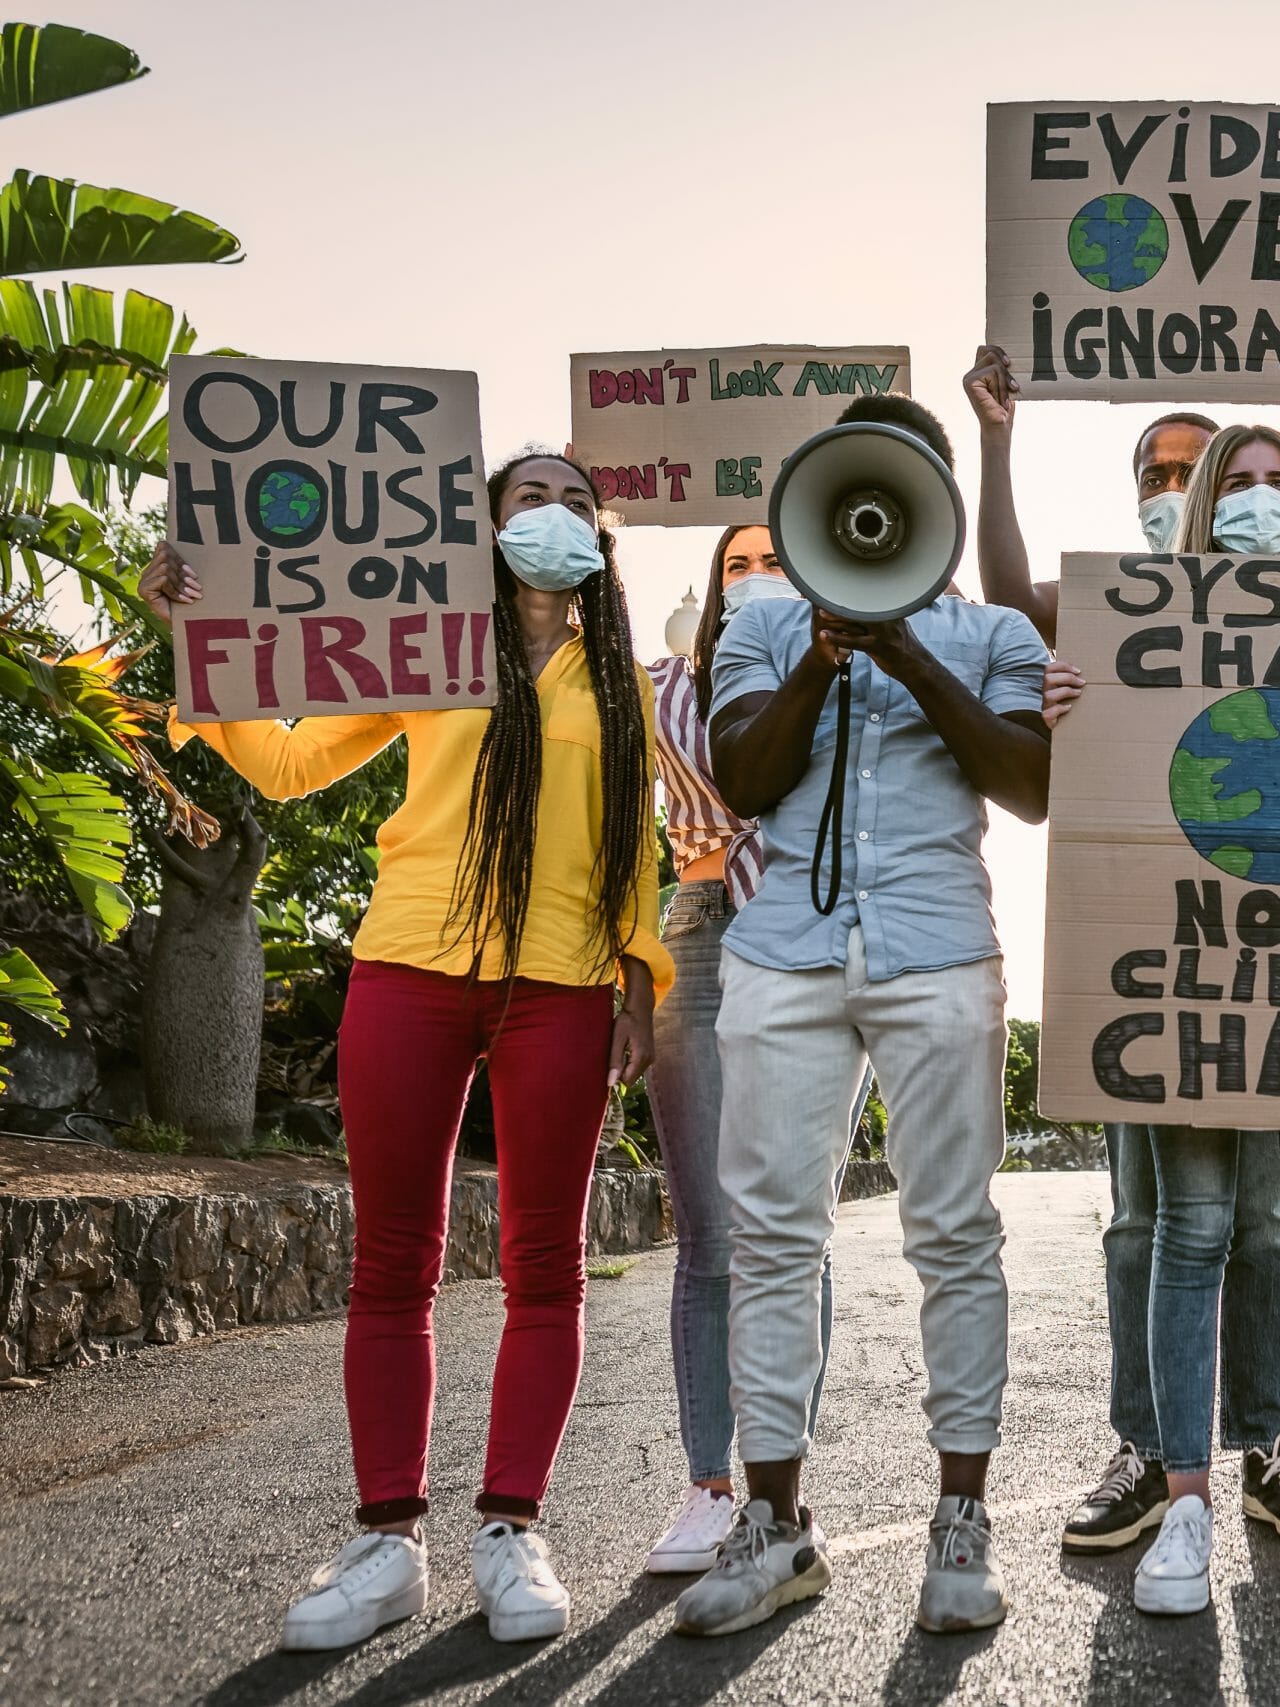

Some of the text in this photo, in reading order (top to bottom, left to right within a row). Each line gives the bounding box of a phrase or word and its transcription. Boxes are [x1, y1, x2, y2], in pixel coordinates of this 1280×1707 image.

[588, 358, 696, 408] DON'T
[792, 361, 898, 396] AWAY
[183, 371, 439, 454] OUR
[173, 454, 477, 550] HOUSE
[590, 456, 763, 502] DON'T BE
[347, 554, 449, 606] ON
